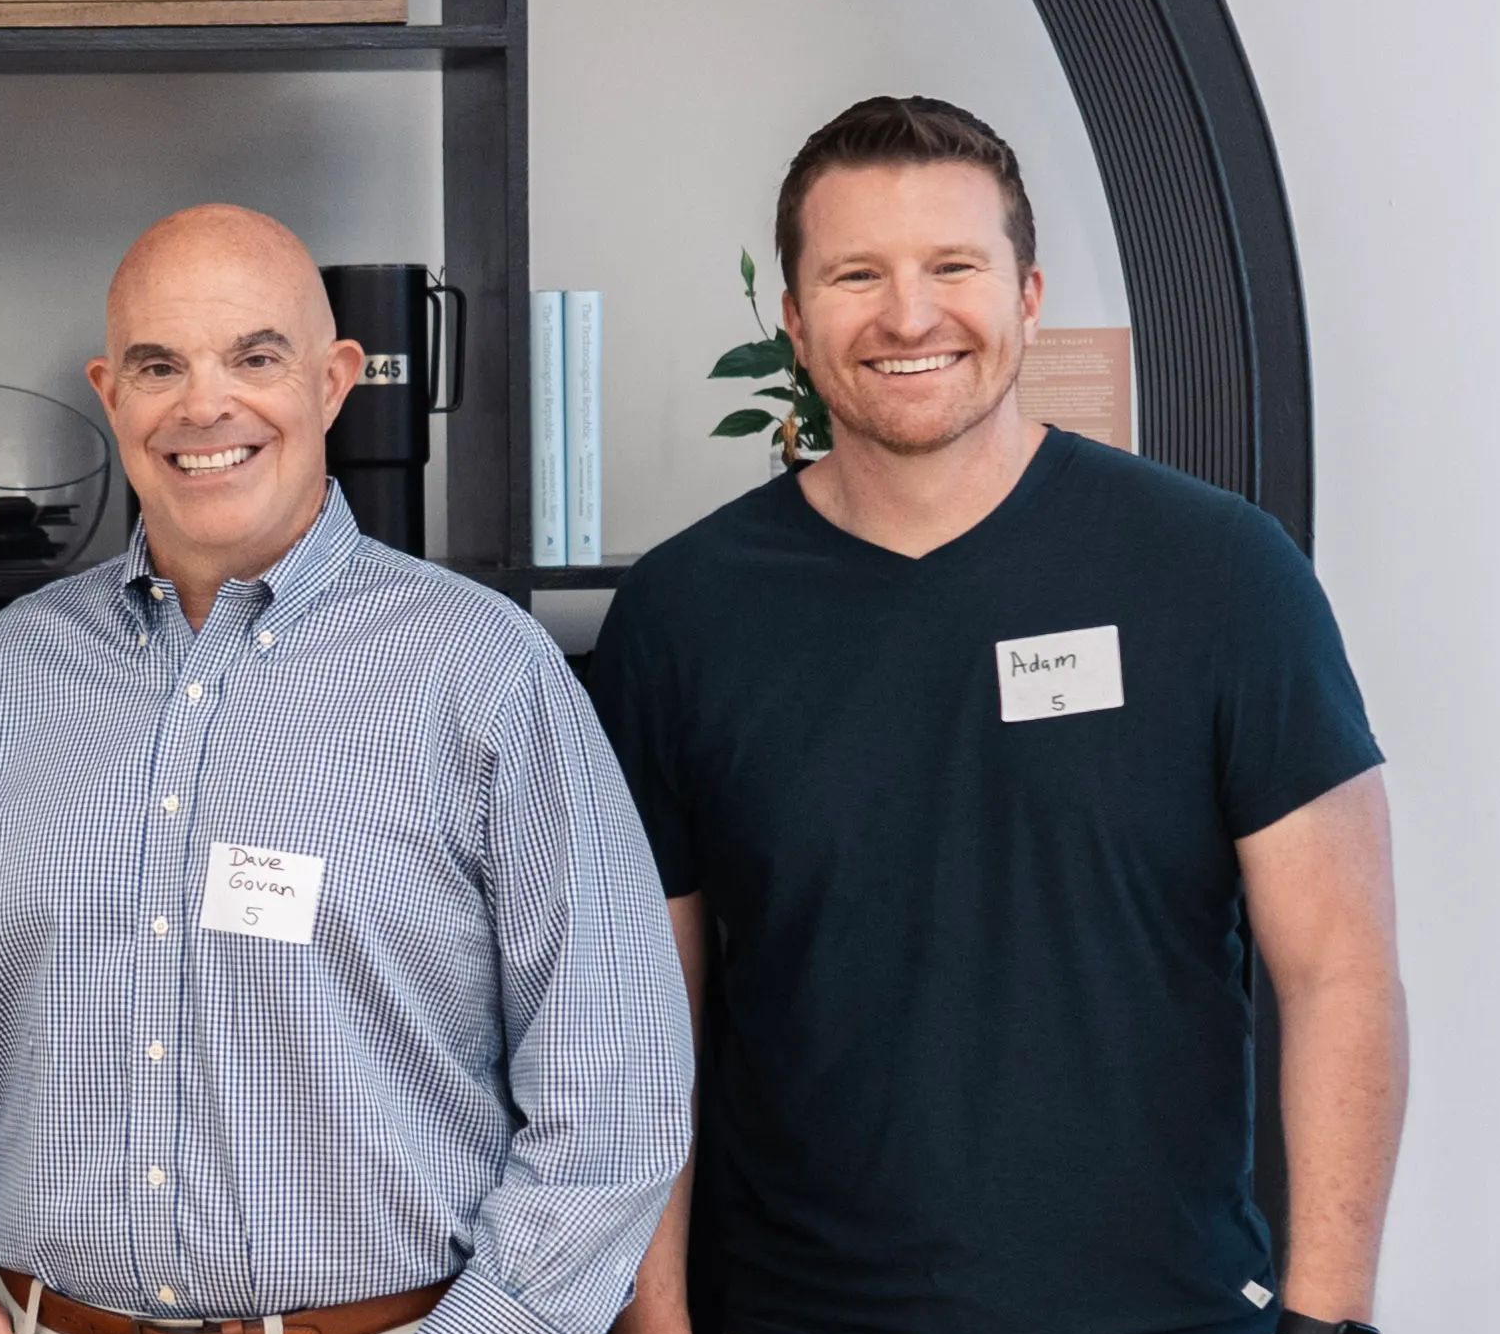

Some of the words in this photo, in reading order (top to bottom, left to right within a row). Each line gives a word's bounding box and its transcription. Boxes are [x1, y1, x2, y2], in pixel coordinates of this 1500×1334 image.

[582, 302, 592, 323] The
[364, 359, 402, 379] 645
[1009, 650, 1077, 678] Adam
[1050, 694, 1066, 712] 5
[228, 847, 285, 871] Dave
[229, 871, 296, 898] Govan
[242, 906, 264, 926] 5
